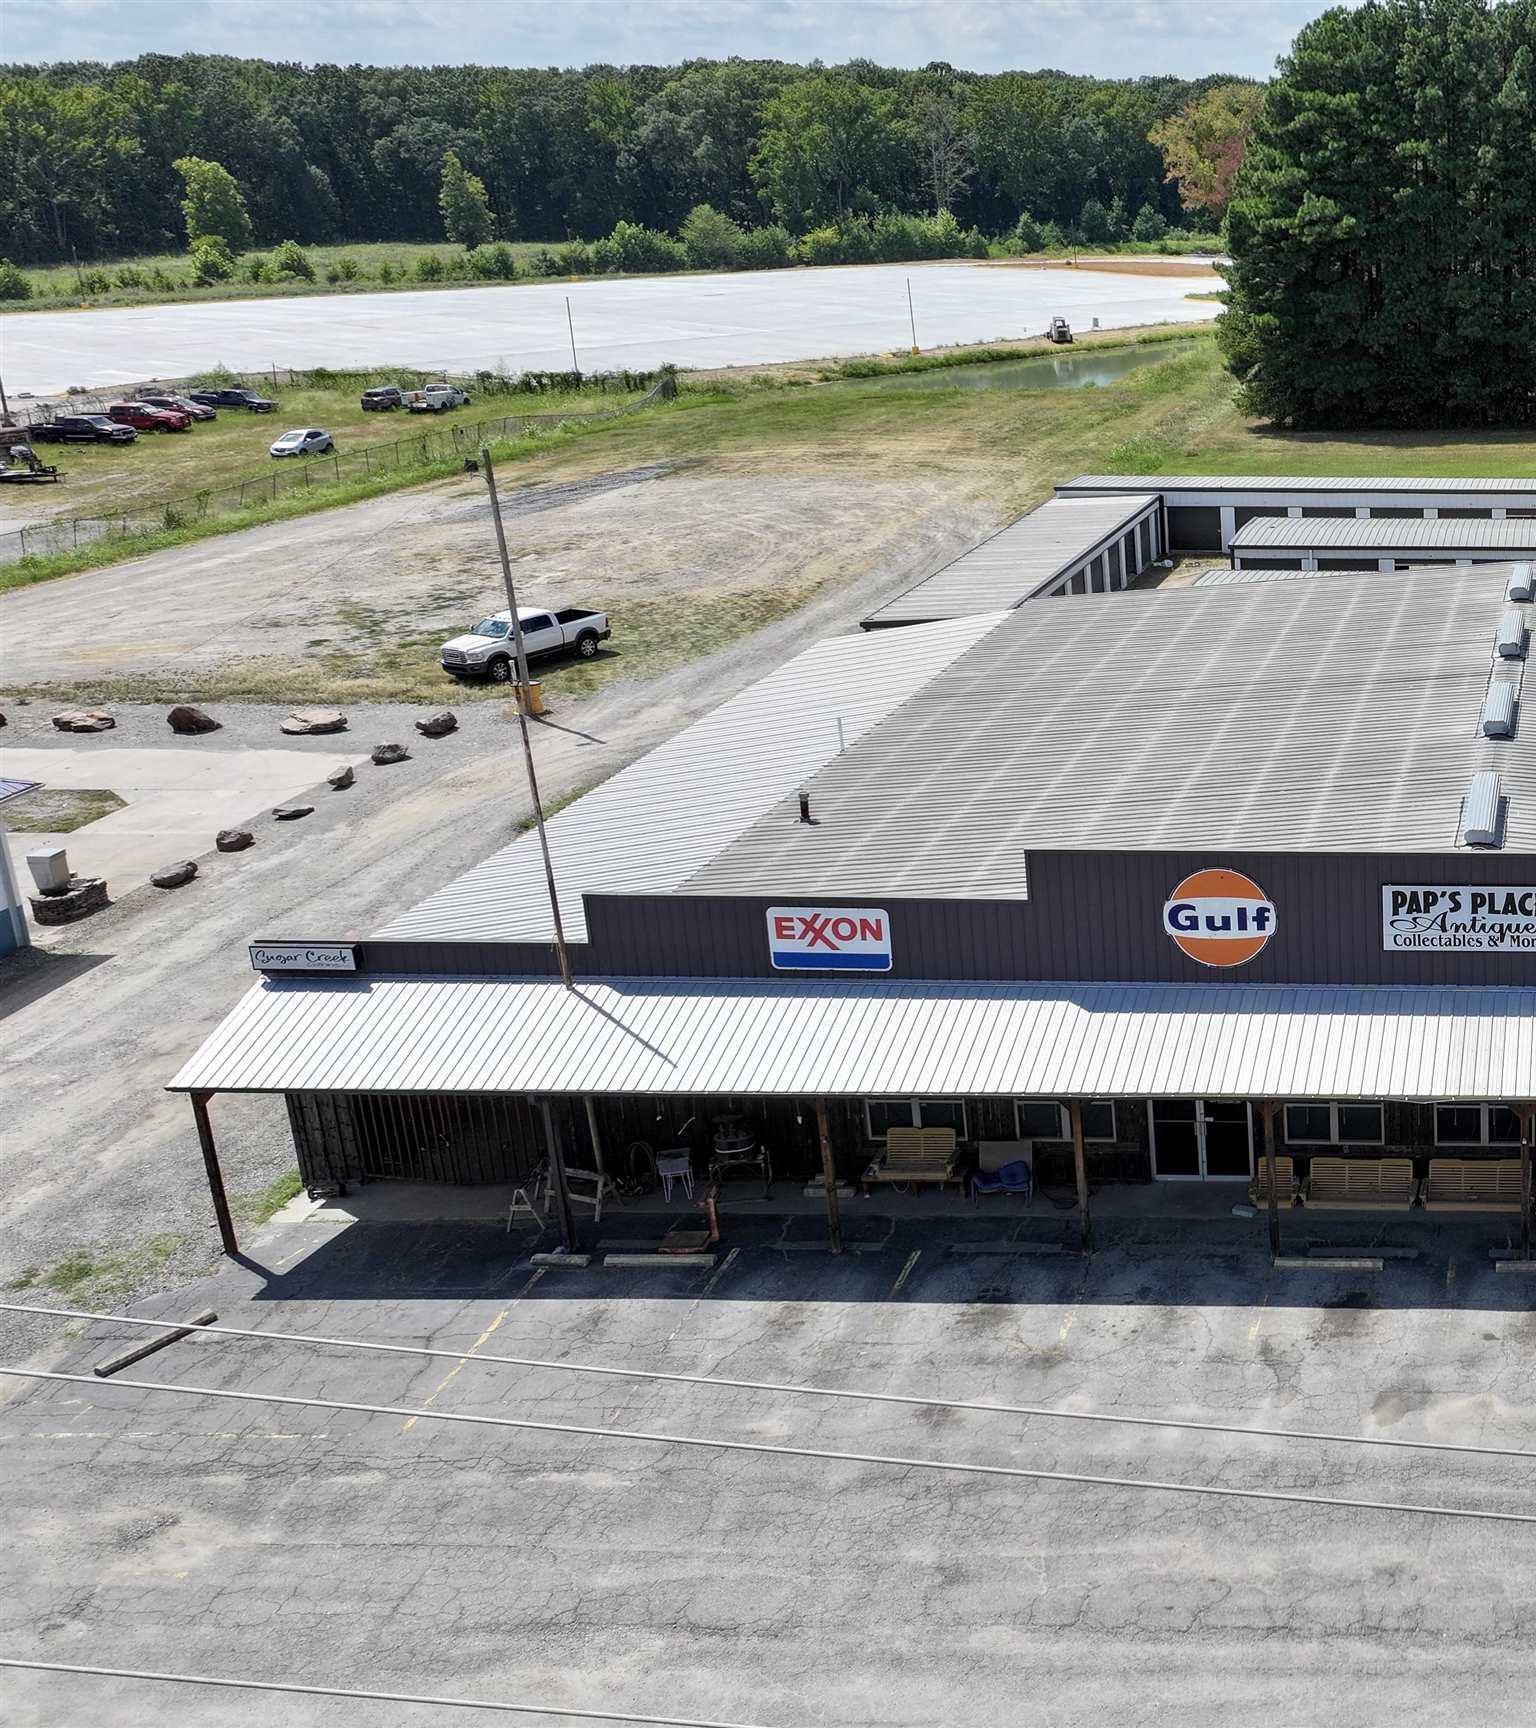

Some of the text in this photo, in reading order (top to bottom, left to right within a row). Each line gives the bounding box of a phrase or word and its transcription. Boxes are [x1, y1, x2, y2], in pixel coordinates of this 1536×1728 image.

[1391, 890, 1462, 916] PAP'S
[1168, 903, 1271, 931] Gulf
[774, 913, 884, 950] EXXON
[1393, 933, 1483, 948] Collectables
[1487, 935, 1500, 947] &
[255, 949, 349, 965] Sugar Creek
